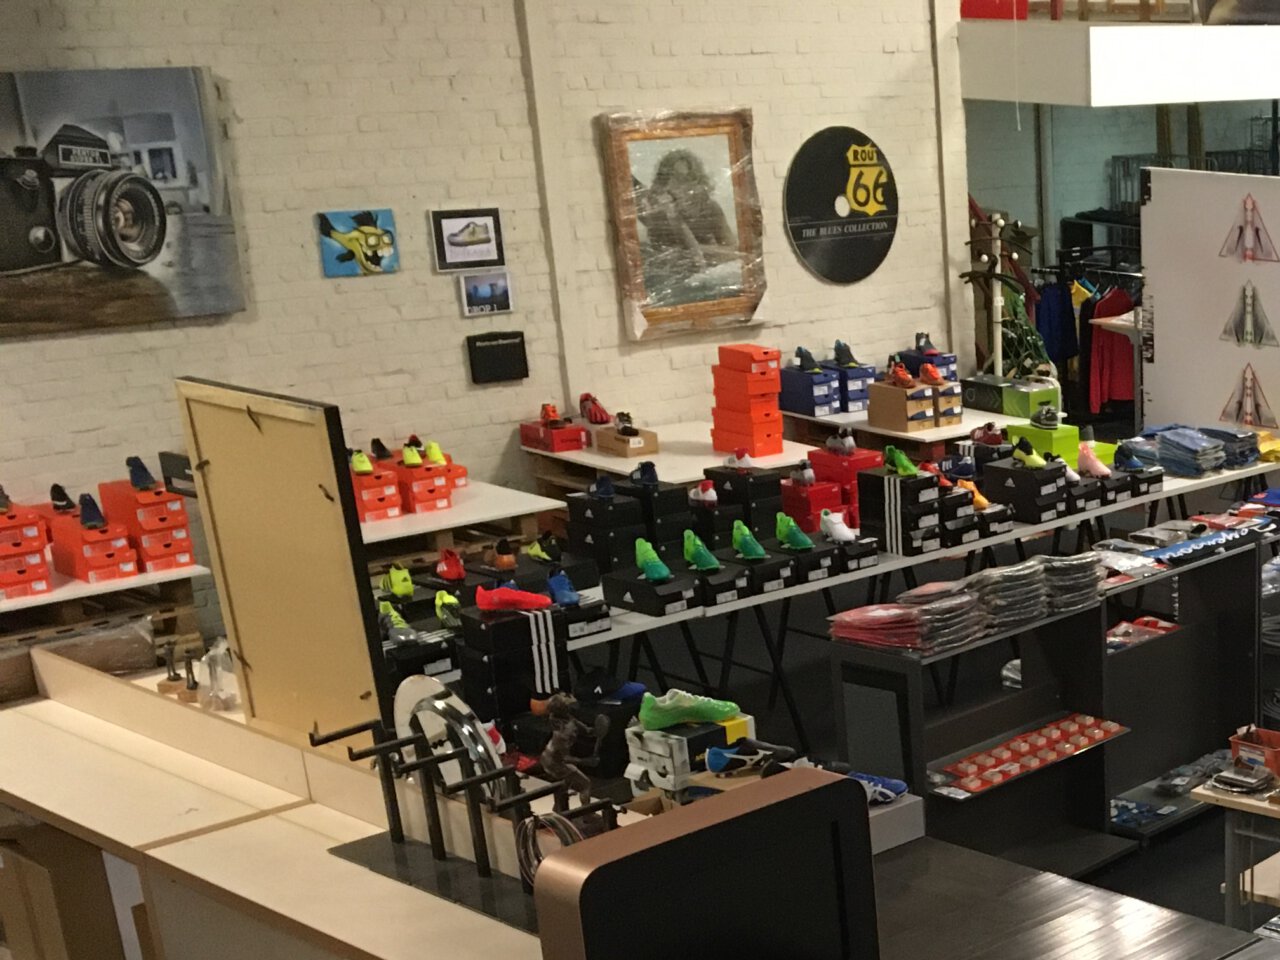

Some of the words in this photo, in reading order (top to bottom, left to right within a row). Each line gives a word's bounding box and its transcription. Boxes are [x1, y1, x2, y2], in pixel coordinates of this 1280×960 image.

[853, 149, 878, 162] ROU
[853, 170, 885, 207] 66
[802, 228, 817, 238] THE
[819, 225, 842, 236] BLUES
[844, 221, 888, 233] COLLECTION
